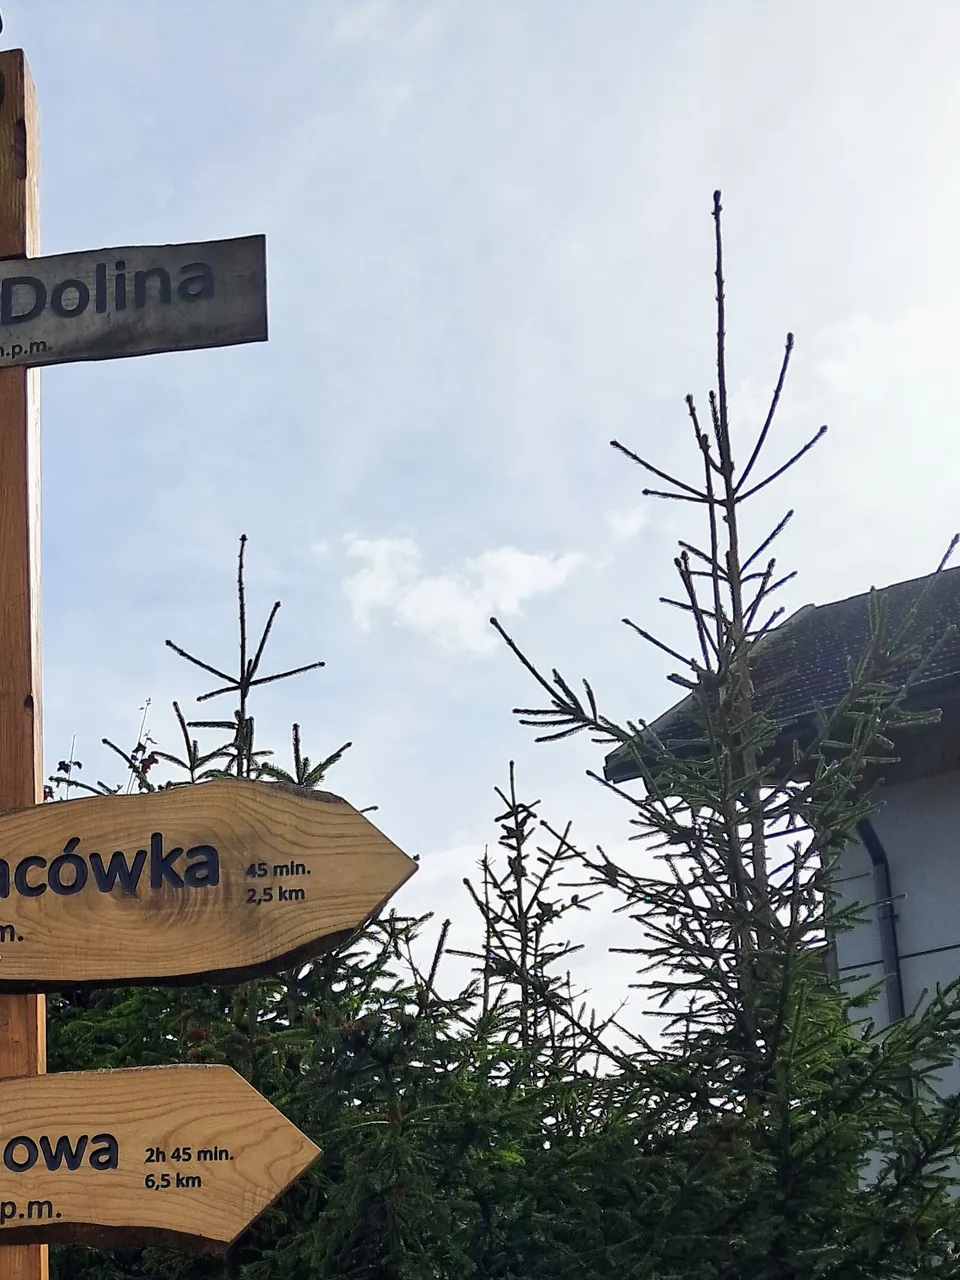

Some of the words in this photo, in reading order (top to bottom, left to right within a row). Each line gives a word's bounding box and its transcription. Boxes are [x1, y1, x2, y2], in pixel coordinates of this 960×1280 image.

[0, 259, 215, 326] Dolina
[246, 862, 268, 878] 45
[273, 860, 312, 877] min.
[246, 886, 274, 906] 2,5
[278, 885, 306, 902] km
[144, 1146, 166, 1163] 2h
[170, 1146, 193, 1162] 45
[197, 1145, 235, 1162] min.
[144, 1173, 172, 1191] 6,5
[175, 1172, 202, 1188] km
